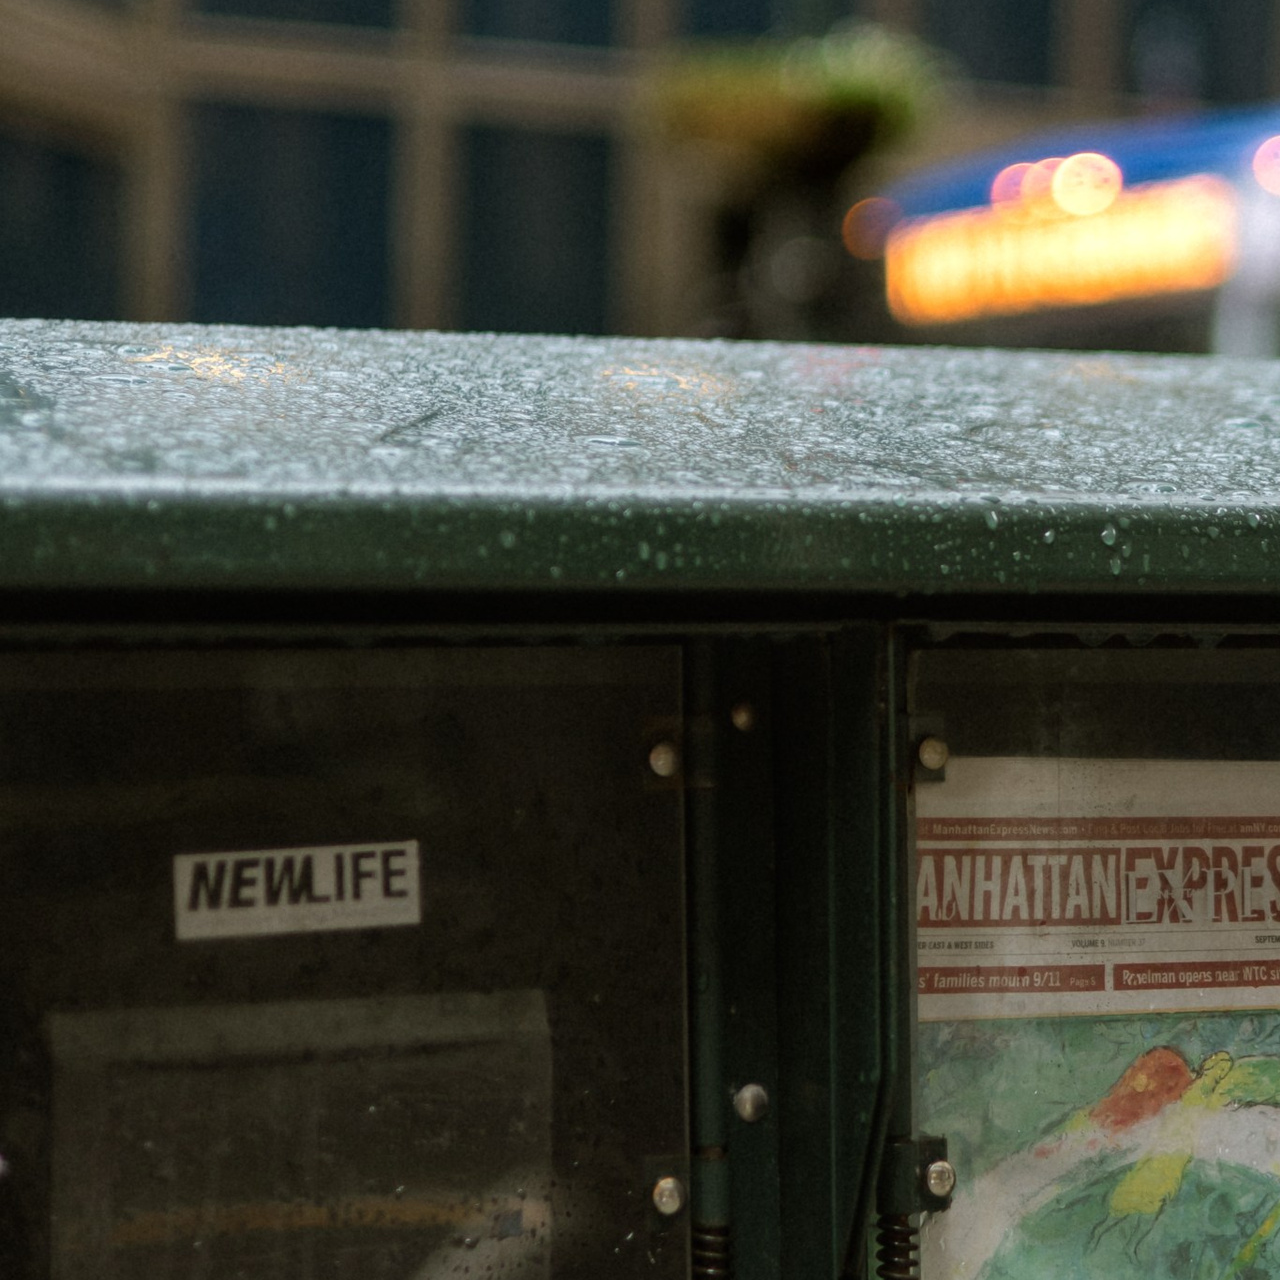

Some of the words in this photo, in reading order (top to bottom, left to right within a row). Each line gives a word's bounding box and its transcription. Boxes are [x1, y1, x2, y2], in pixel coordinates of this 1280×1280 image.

[953, 940, 973, 950] WEST
[973, 939, 994, 949] SIDES
[1071, 939, 1100, 949] VOLUME
[934, 972, 985, 988] families
[989, 974, 1029, 987] mourn
[1033, 971, 1061, 988] 9/11
[1070, 977, 1090, 987] Page
[1179, 971, 1212, 986] opens
[1215, 970, 1240, 983] near
[1243, 966, 1267, 982] WTC
